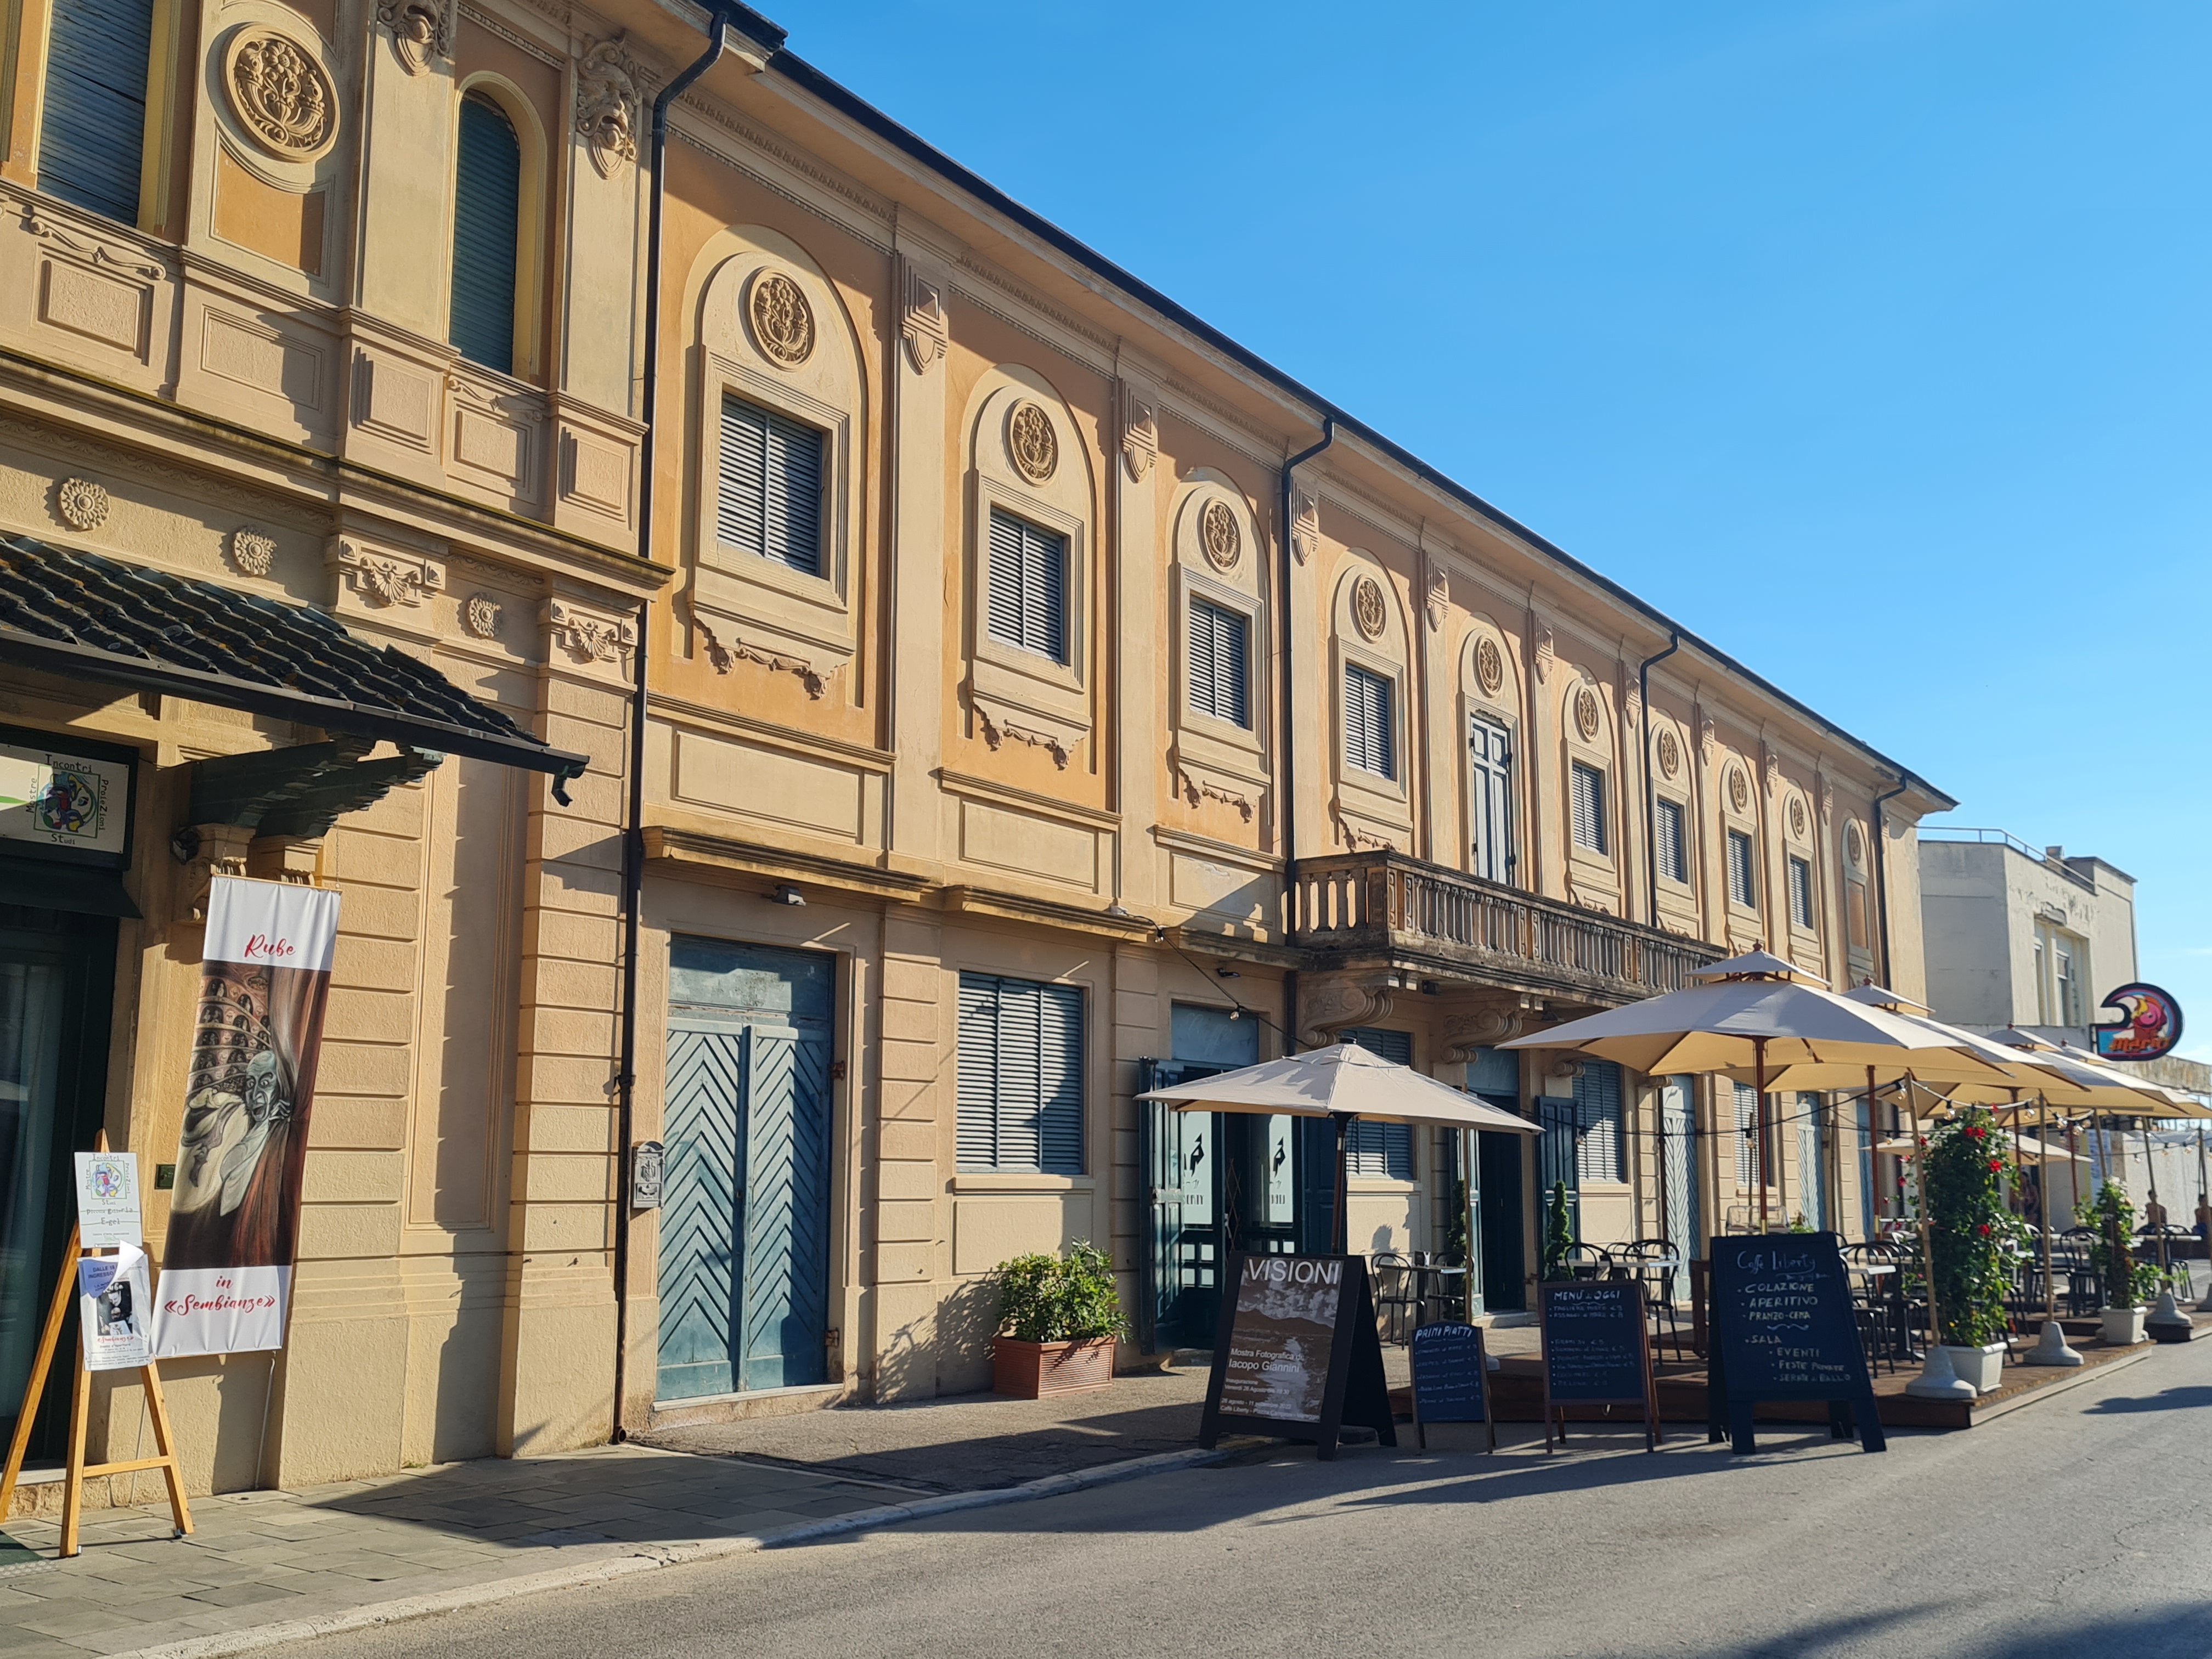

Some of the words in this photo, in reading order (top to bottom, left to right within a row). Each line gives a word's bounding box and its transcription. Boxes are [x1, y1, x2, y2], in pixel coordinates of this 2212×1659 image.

[45, 754, 92, 772] Incontri
[26, 778, 37, 813] Mostre
[51, 833, 76, 845] Studi
[244, 934, 296, 958] Rube
[1249, 1259, 1339, 1284] VISIONI
[216, 1276, 233, 1289] in
[1745, 1282, 1814, 1293] COLAZIONE
[1750, 1296, 1818, 1308] APERITIVO
[1751, 1335, 1782, 1344] SALA
[1231, 1348, 1254, 1357] Mostra
[1256, 1350, 1294, 1361] Fotografica
[1776, 1347, 1820, 1358] EVENTI
[1228, 1358, 1260, 1371] Iacopo
[1261, 1361, 1300, 1373] Giannini
